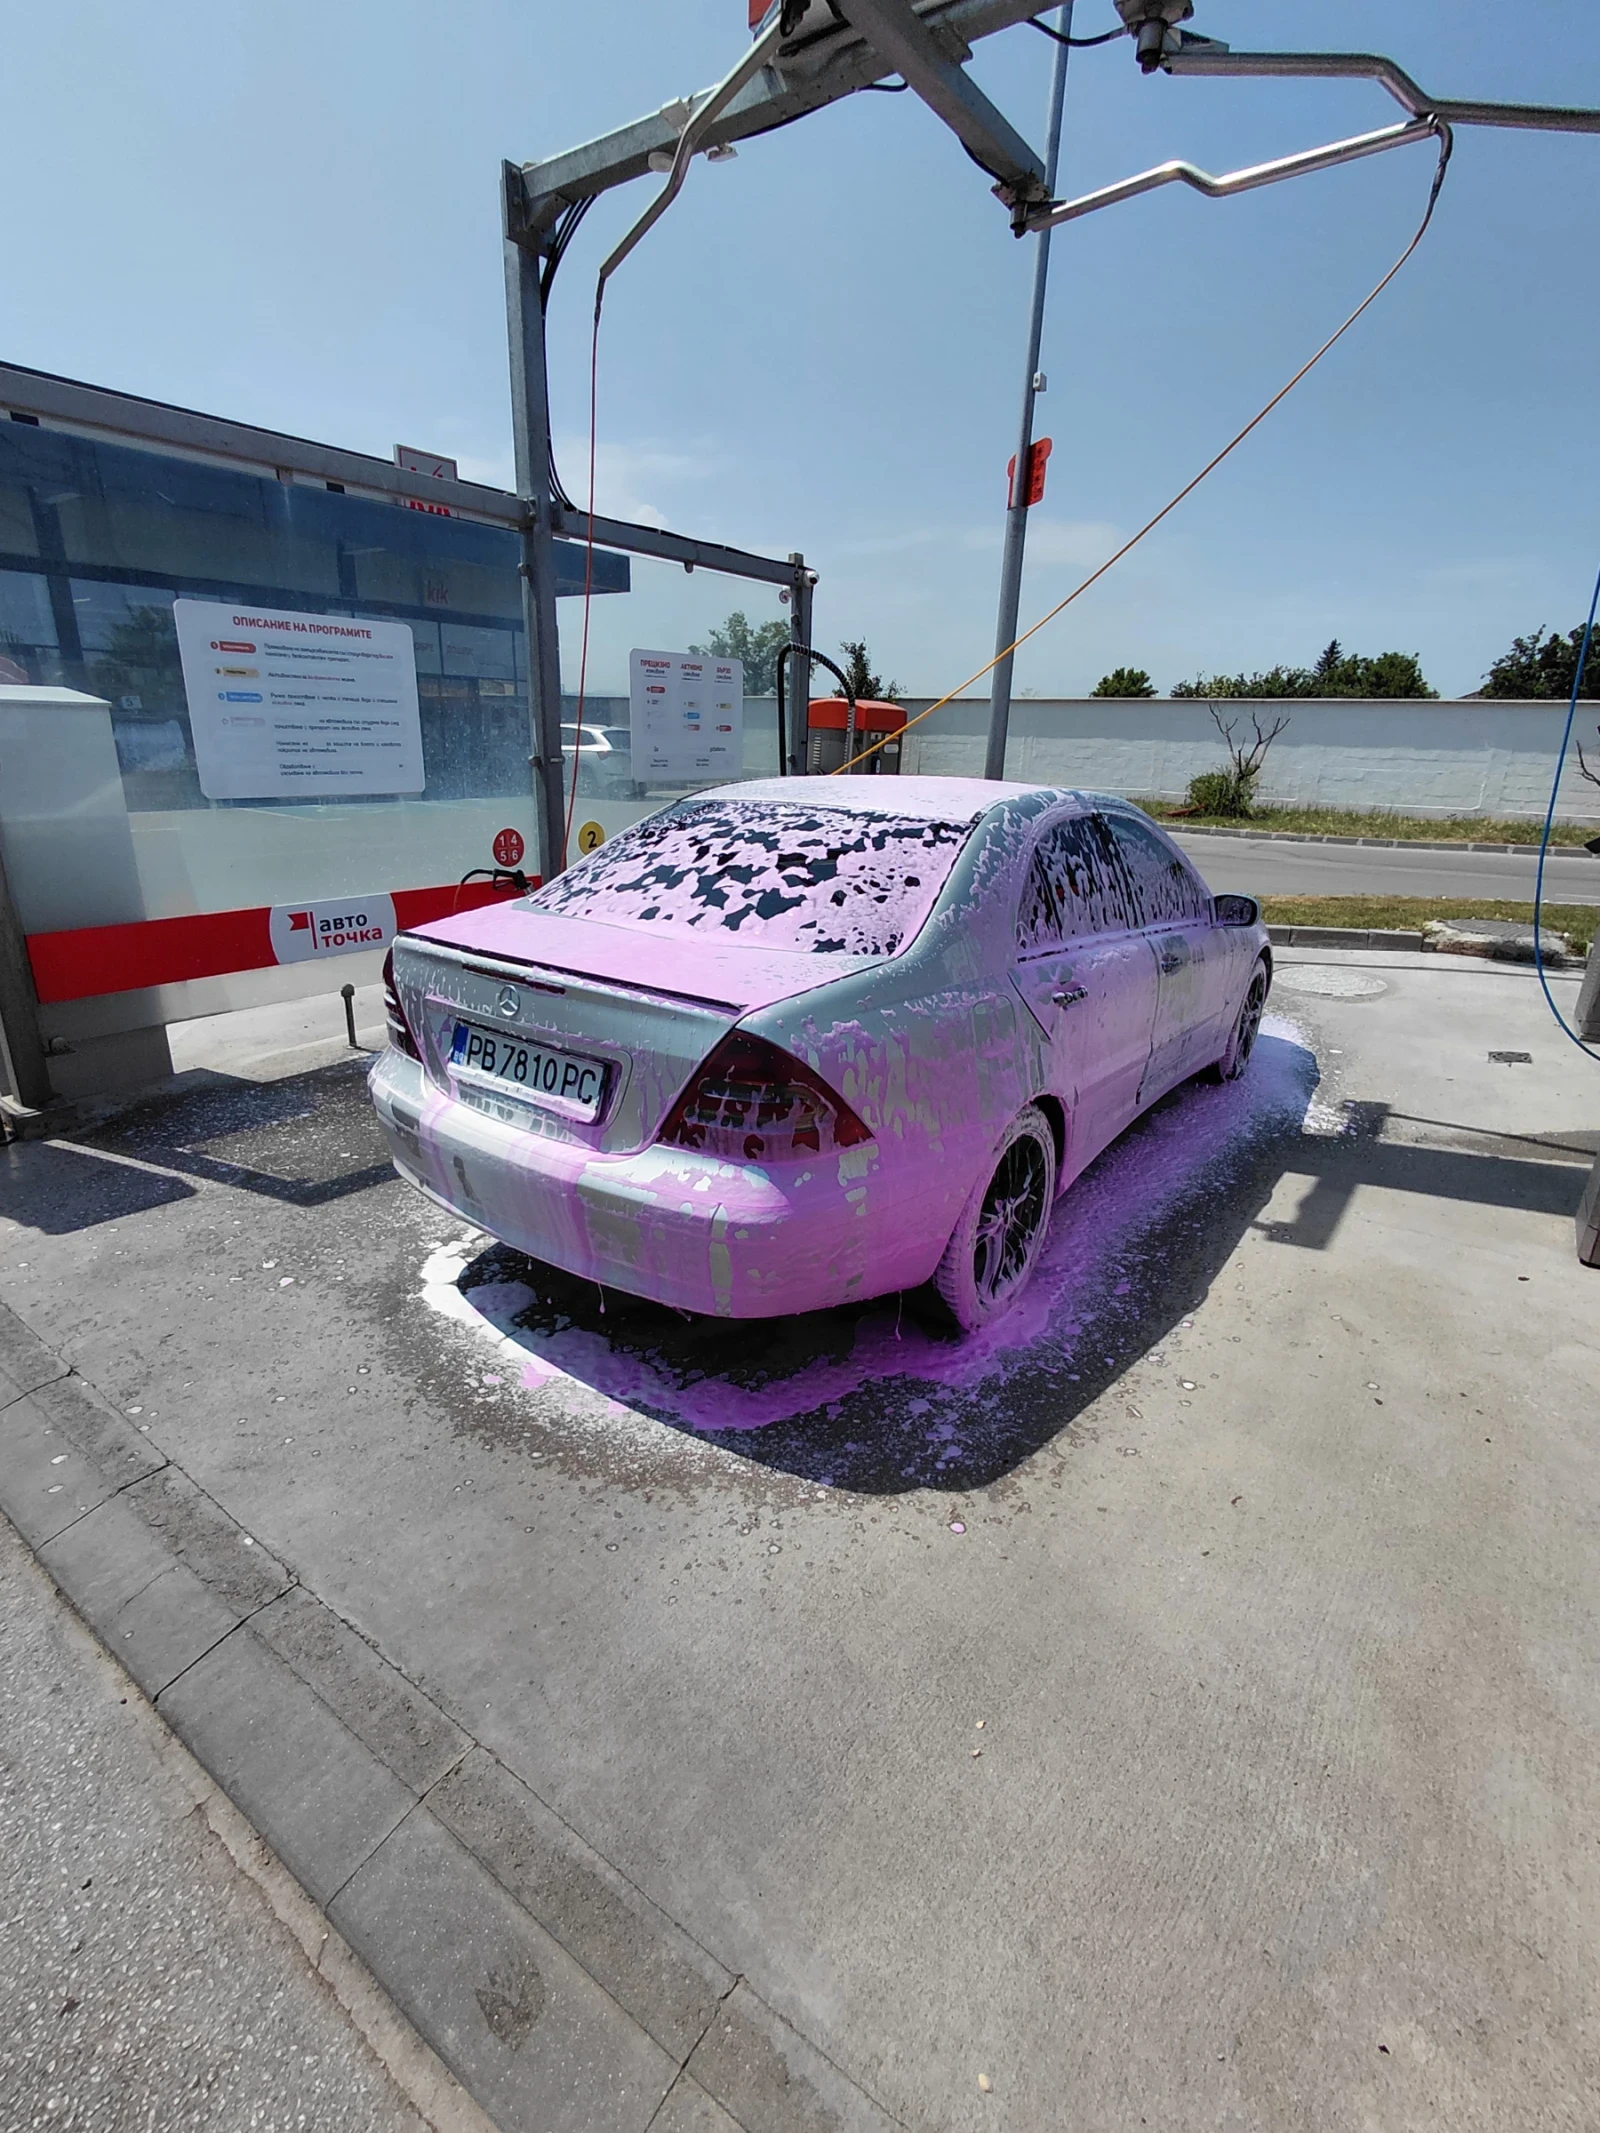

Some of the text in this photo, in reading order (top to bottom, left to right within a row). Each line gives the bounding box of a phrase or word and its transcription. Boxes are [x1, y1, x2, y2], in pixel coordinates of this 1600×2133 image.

[232, 616, 373, 639] ОПИСАНИЕ НА ПРОГРАМИТЕ
[499, 834, 518, 847] 1 4
[587, 830, 597, 849] 2
[500, 849, 519, 862] 5 6
[319, 913, 368, 933] авто
[321, 927, 383, 948] точка
